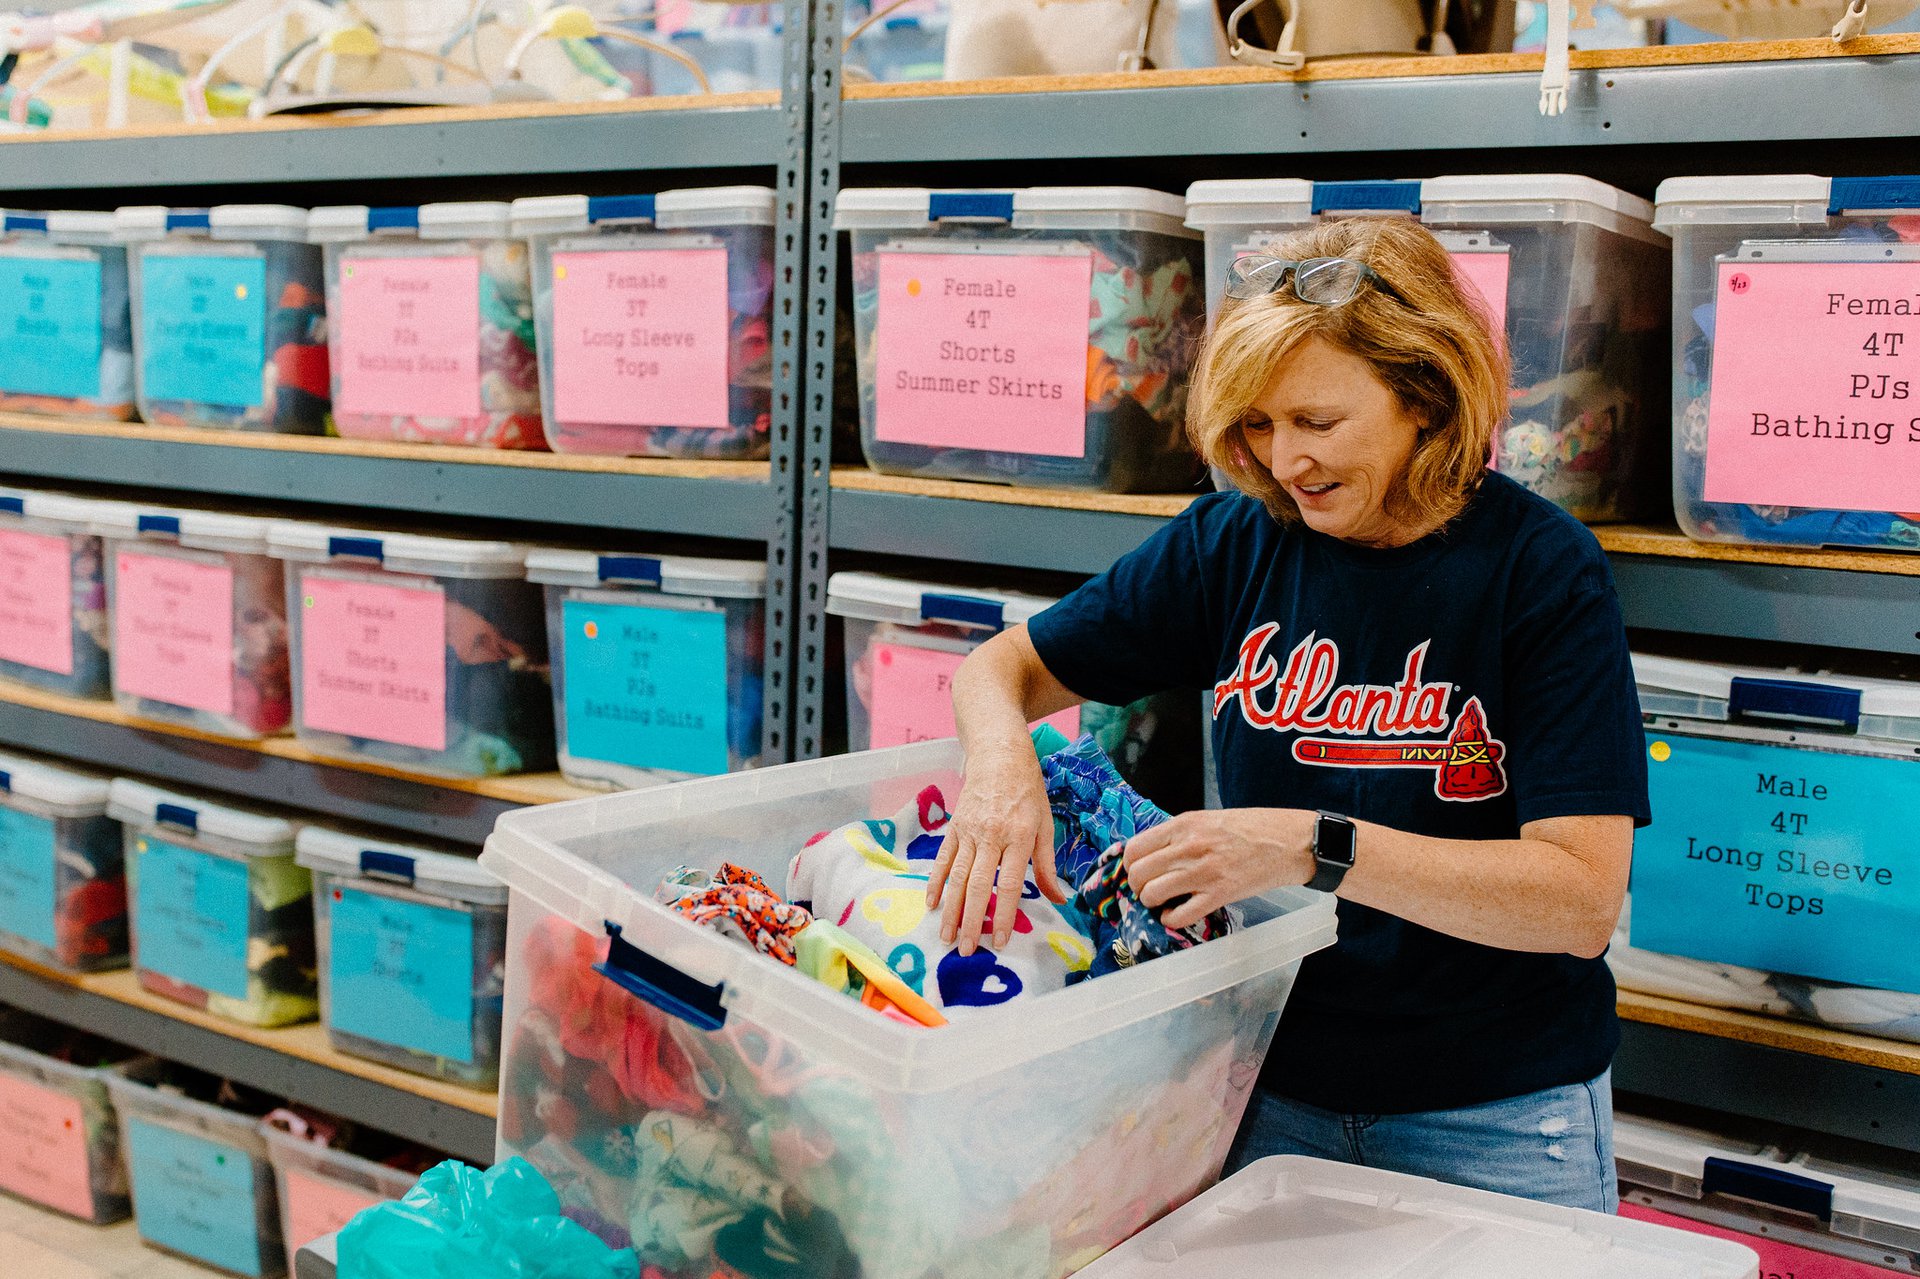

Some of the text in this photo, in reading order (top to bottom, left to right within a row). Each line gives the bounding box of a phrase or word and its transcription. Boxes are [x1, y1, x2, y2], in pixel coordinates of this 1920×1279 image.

[606, 271, 667, 290] Female
[943, 278, 1016, 298] Female
[625, 300, 647, 318] 3T
[965, 310, 991, 329] 4T
[582, 328, 695, 349] Long Sleeve
[1863, 332, 1904, 357] 4T
[940, 341, 1016, 364] Shorts
[615, 357, 659, 378] Tops
[896, 371, 1063, 400] Summer Skirts
[1849, 374, 1910, 400] PJs
[1751, 413, 1895, 445] Bathing
[622, 624, 659, 643] Male
[1213, 621, 1454, 736] Atlanta
[656, 706, 704, 731] Suits
[1756, 773, 1828, 801] Male
[1770, 811, 1809, 835] 4T
[1687, 837, 1893, 886] Long Sleeve
[1746, 883, 1824, 915] Tops
